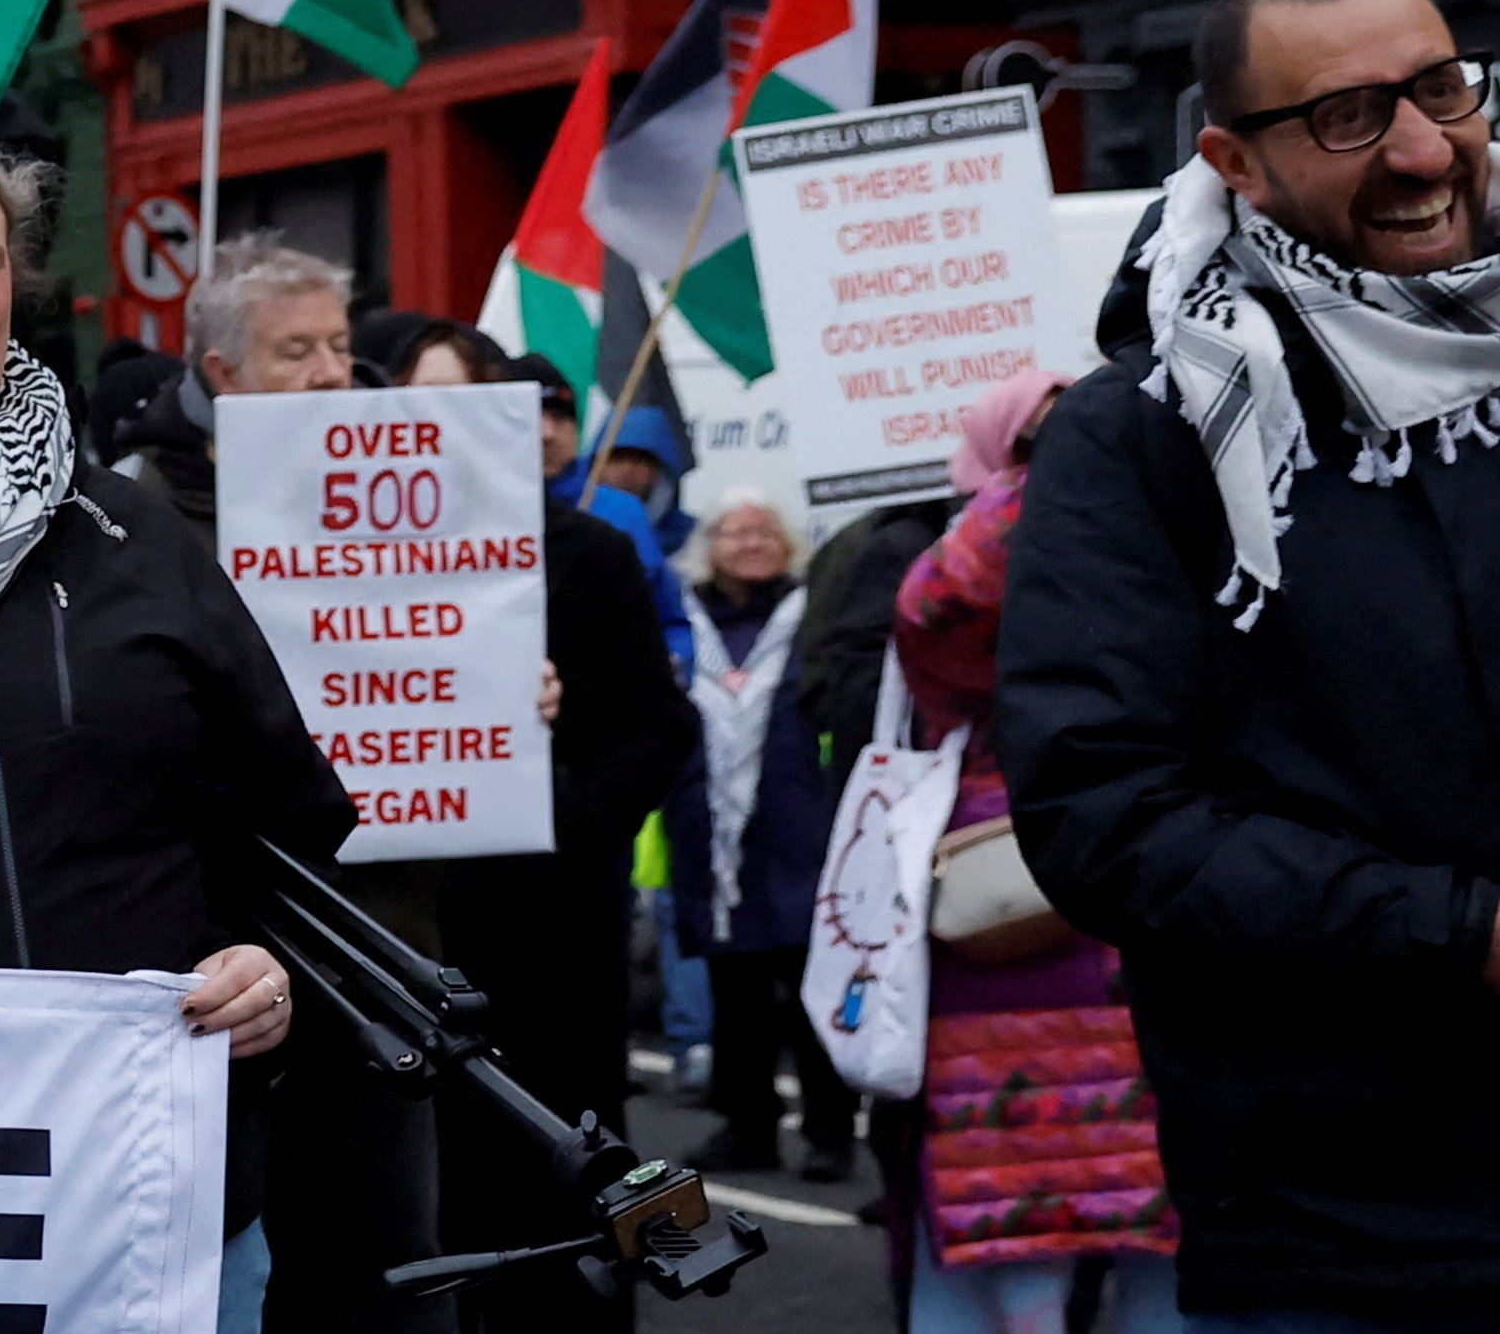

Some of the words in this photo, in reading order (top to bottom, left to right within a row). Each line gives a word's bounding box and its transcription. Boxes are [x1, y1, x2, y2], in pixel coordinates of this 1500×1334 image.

[930, 102, 1023, 136] CRIME
[798, 178, 830, 211] IS
[832, 161, 935, 205] THERE
[943, 153, 1004, 188] ANY
[836, 212, 933, 255] CRIME
[940, 204, 982, 240] BY
[831, 262, 936, 305] WHICH
[940, 250, 1009, 289] OUR
[821, 295, 1035, 356] GOVERNMENT
[838, 366, 915, 403] WILL
[920, 346, 1037, 389] PUNISH
[324, 422, 442, 459] OVER
[321, 468, 441, 532] 500
[231, 536, 538, 581] PALESTINIANS
[311, 603, 465, 644] KILLED
[322, 669, 457, 707] SINCE
[349, 787, 468, 826] EGAN
